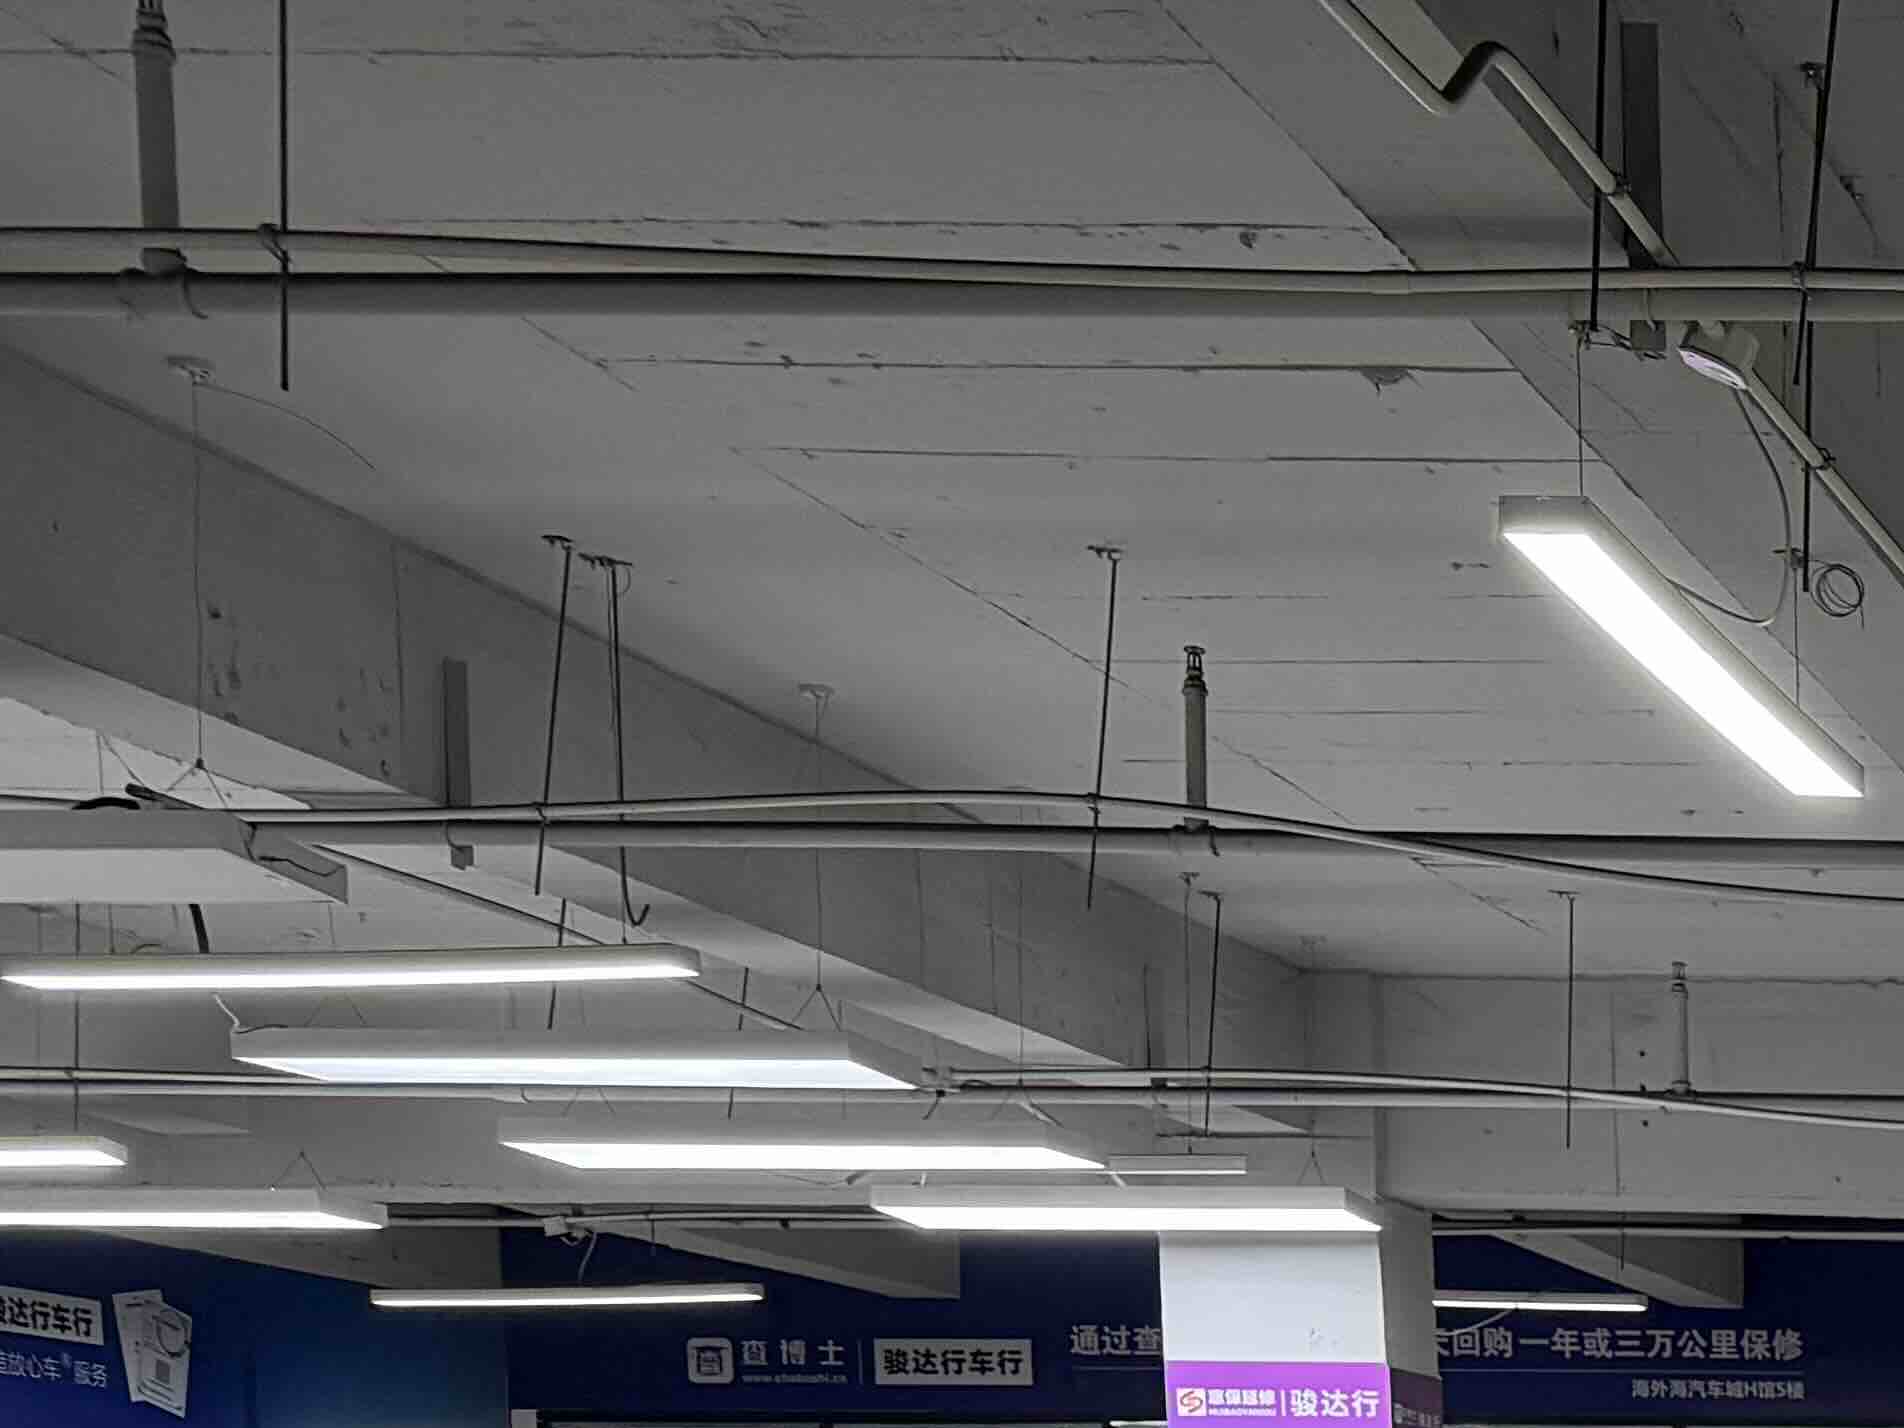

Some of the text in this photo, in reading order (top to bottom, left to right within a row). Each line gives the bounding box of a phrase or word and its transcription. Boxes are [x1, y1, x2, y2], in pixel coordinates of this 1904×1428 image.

[1520, 1327, 1804, 1360] 一年或三万公里保修
[883, 1348, 1024, 1377] 骏达行车行
[1291, 1388, 1379, 1418] 骏达行
